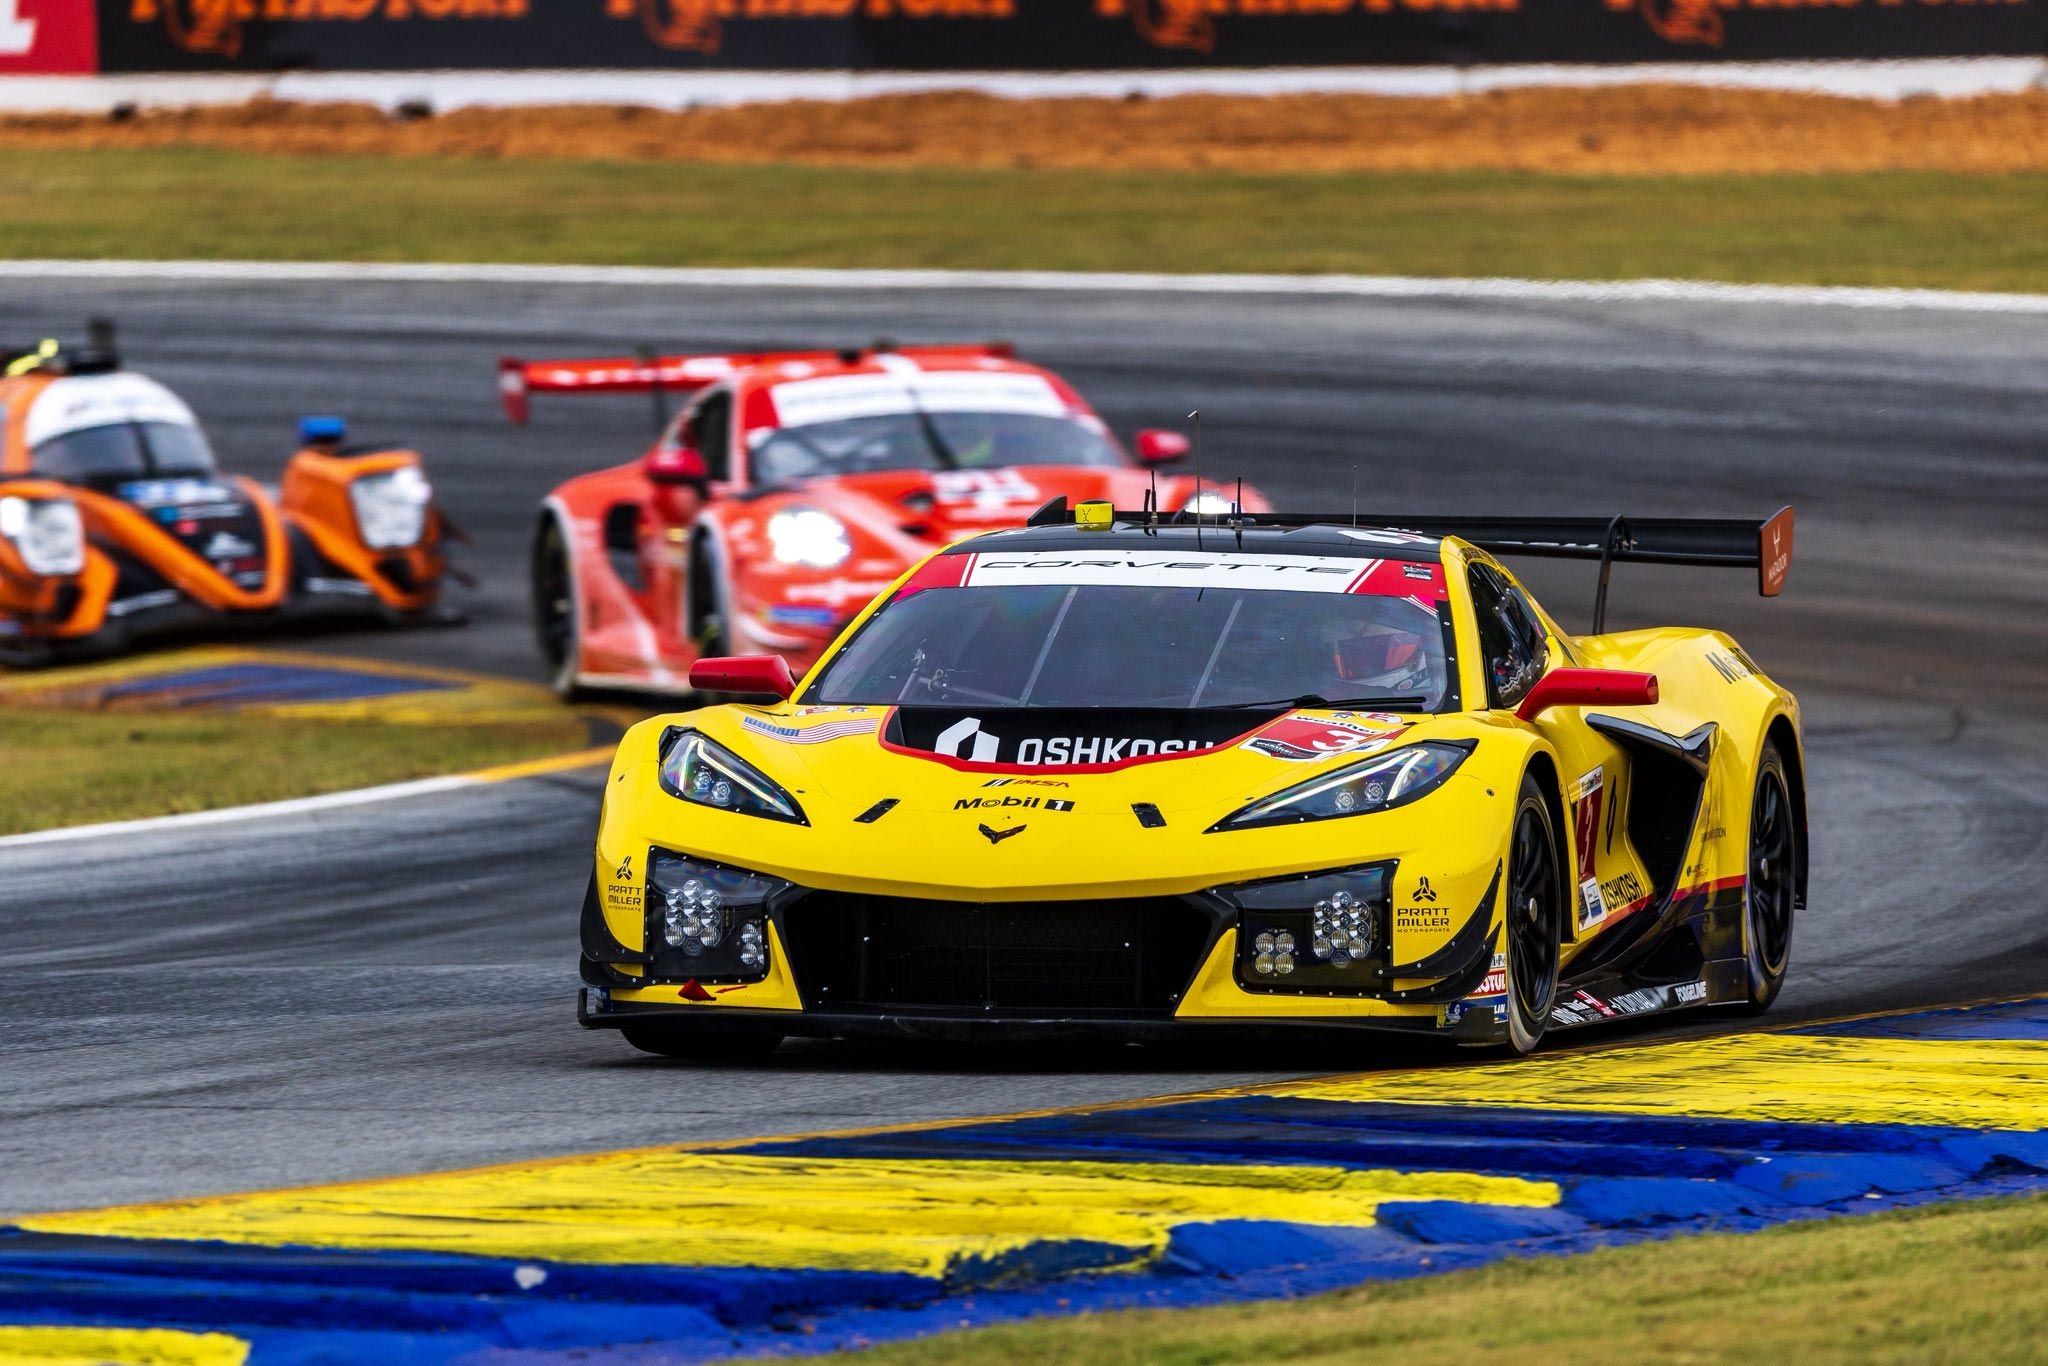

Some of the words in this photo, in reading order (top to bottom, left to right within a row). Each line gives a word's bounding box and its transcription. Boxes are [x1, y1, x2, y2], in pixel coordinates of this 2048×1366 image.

[980, 560, 1355, 575] CORVETTE
[1312, 729, 1360, 751] 3
[1013, 779, 1070, 788] IMSA
[953, 796, 1041, 810] Mobil
[608, 884, 642, 896] PRATT
[1601, 871, 1644, 912] OSHKOSH
[608, 894, 642, 906] MILLER
[1397, 907, 1450, 917] PRATT
[1397, 917, 1450, 927] MILLER
[1473, 974, 1506, 994] OTUL
